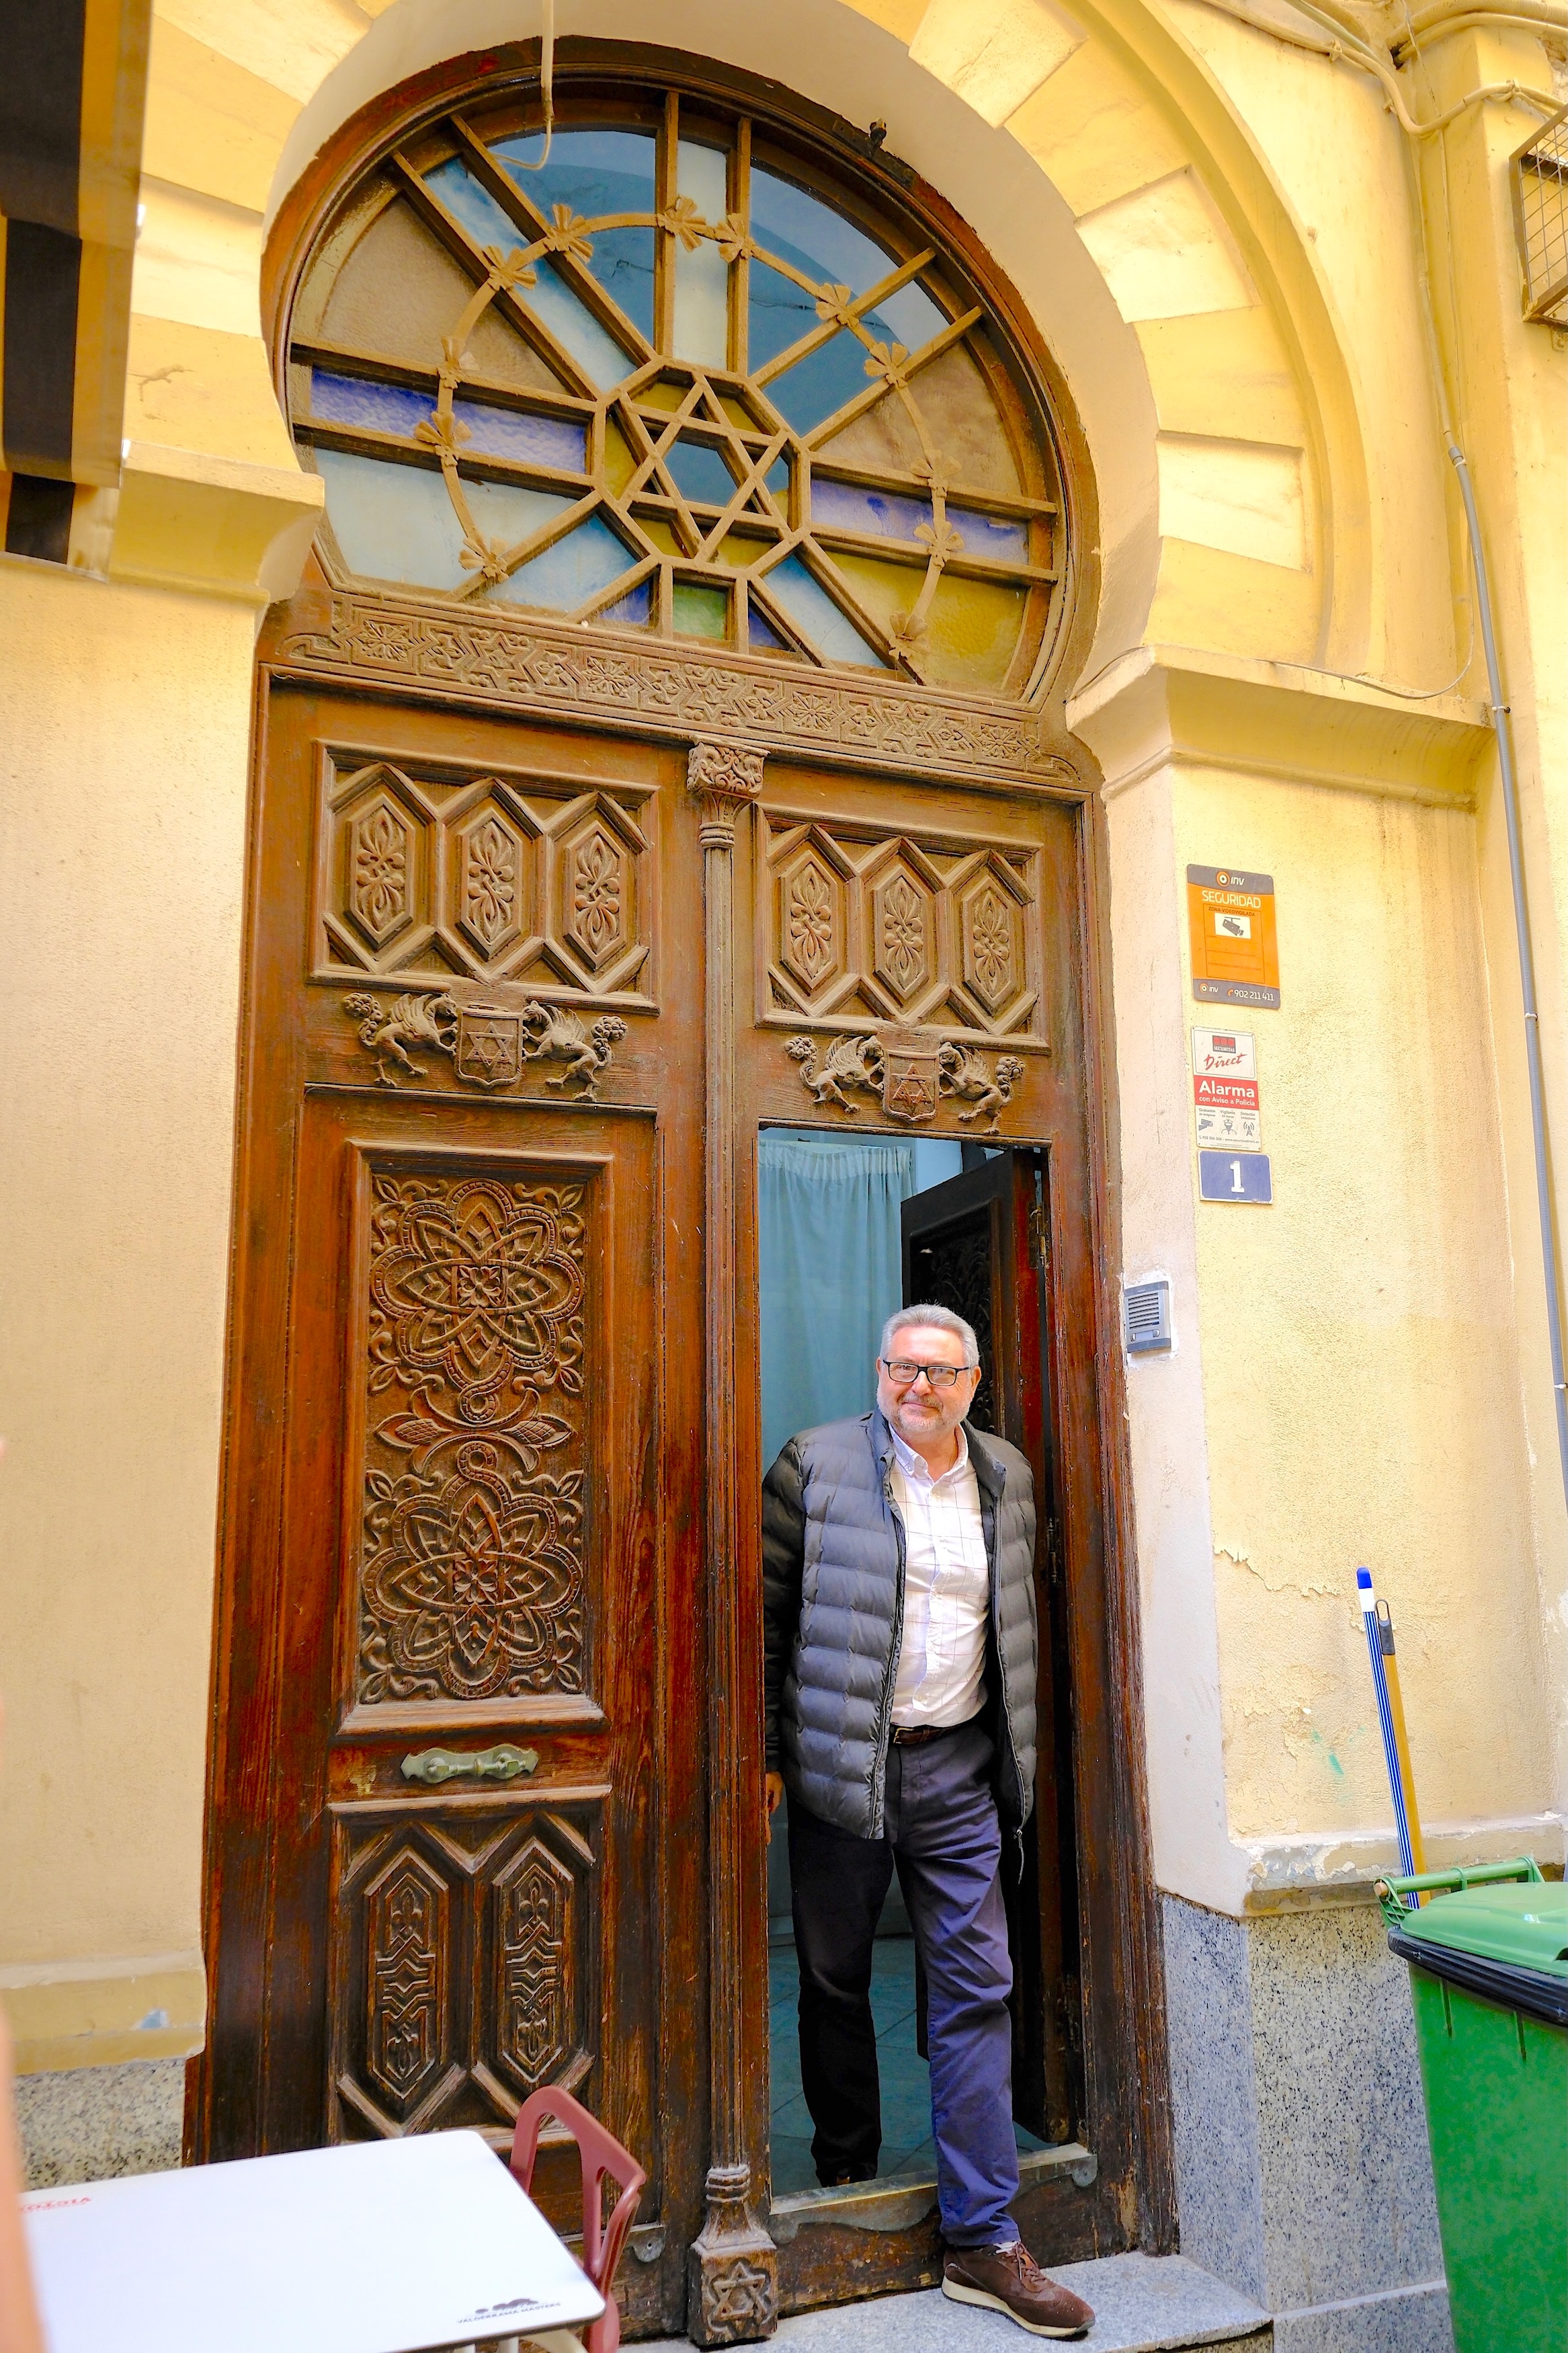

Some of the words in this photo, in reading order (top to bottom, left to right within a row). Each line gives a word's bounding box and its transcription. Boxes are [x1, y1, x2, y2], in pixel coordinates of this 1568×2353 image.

[1202, 890, 1262, 909] SEGURIDAD
[1221, 908, 1255, 916] VIDEOVIGILADA
[1234, 989, 1248, 998] 902
[1249, 991, 1262, 1000] 211
[1262, 992, 1274, 1001] 411
[1203, 1052, 1248, 1071] Direct
[1198, 1080, 1255, 1098] Alarma
[1229, 1160, 1245, 1193] 1
[456, 2309, 519, 2324] VALDERRAMA
[521, 2302, 561, 2313] MASTERS
